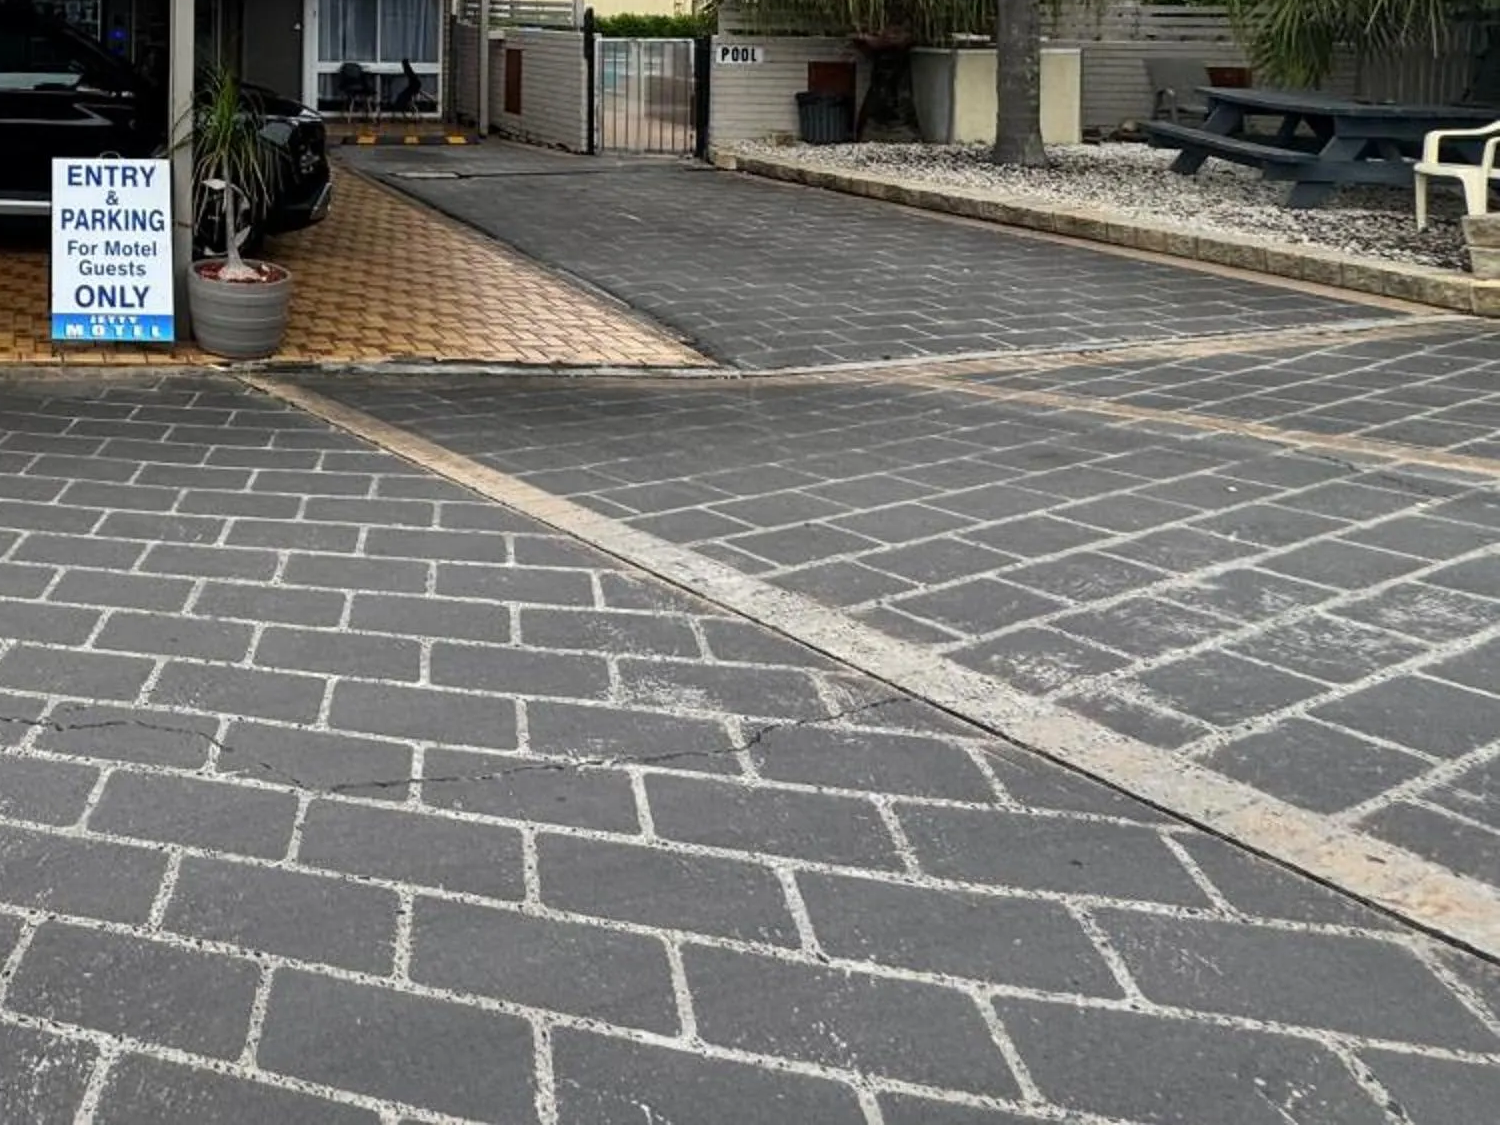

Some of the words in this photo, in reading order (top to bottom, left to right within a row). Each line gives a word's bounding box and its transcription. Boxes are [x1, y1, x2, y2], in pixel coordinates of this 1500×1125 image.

[721, 46, 757, 62] POOL
[67, 165, 156, 188] ENTRY
[105, 190, 119, 206] &
[61, 208, 165, 232] PARKING
[67, 240, 98, 256] For
[105, 240, 157, 257] Motel
[79, 259, 147, 276] Guests
[74, 284, 150, 308] ONLY
[90, 315, 139, 324] JETTY
[64, 324, 163, 338] MOTEL
